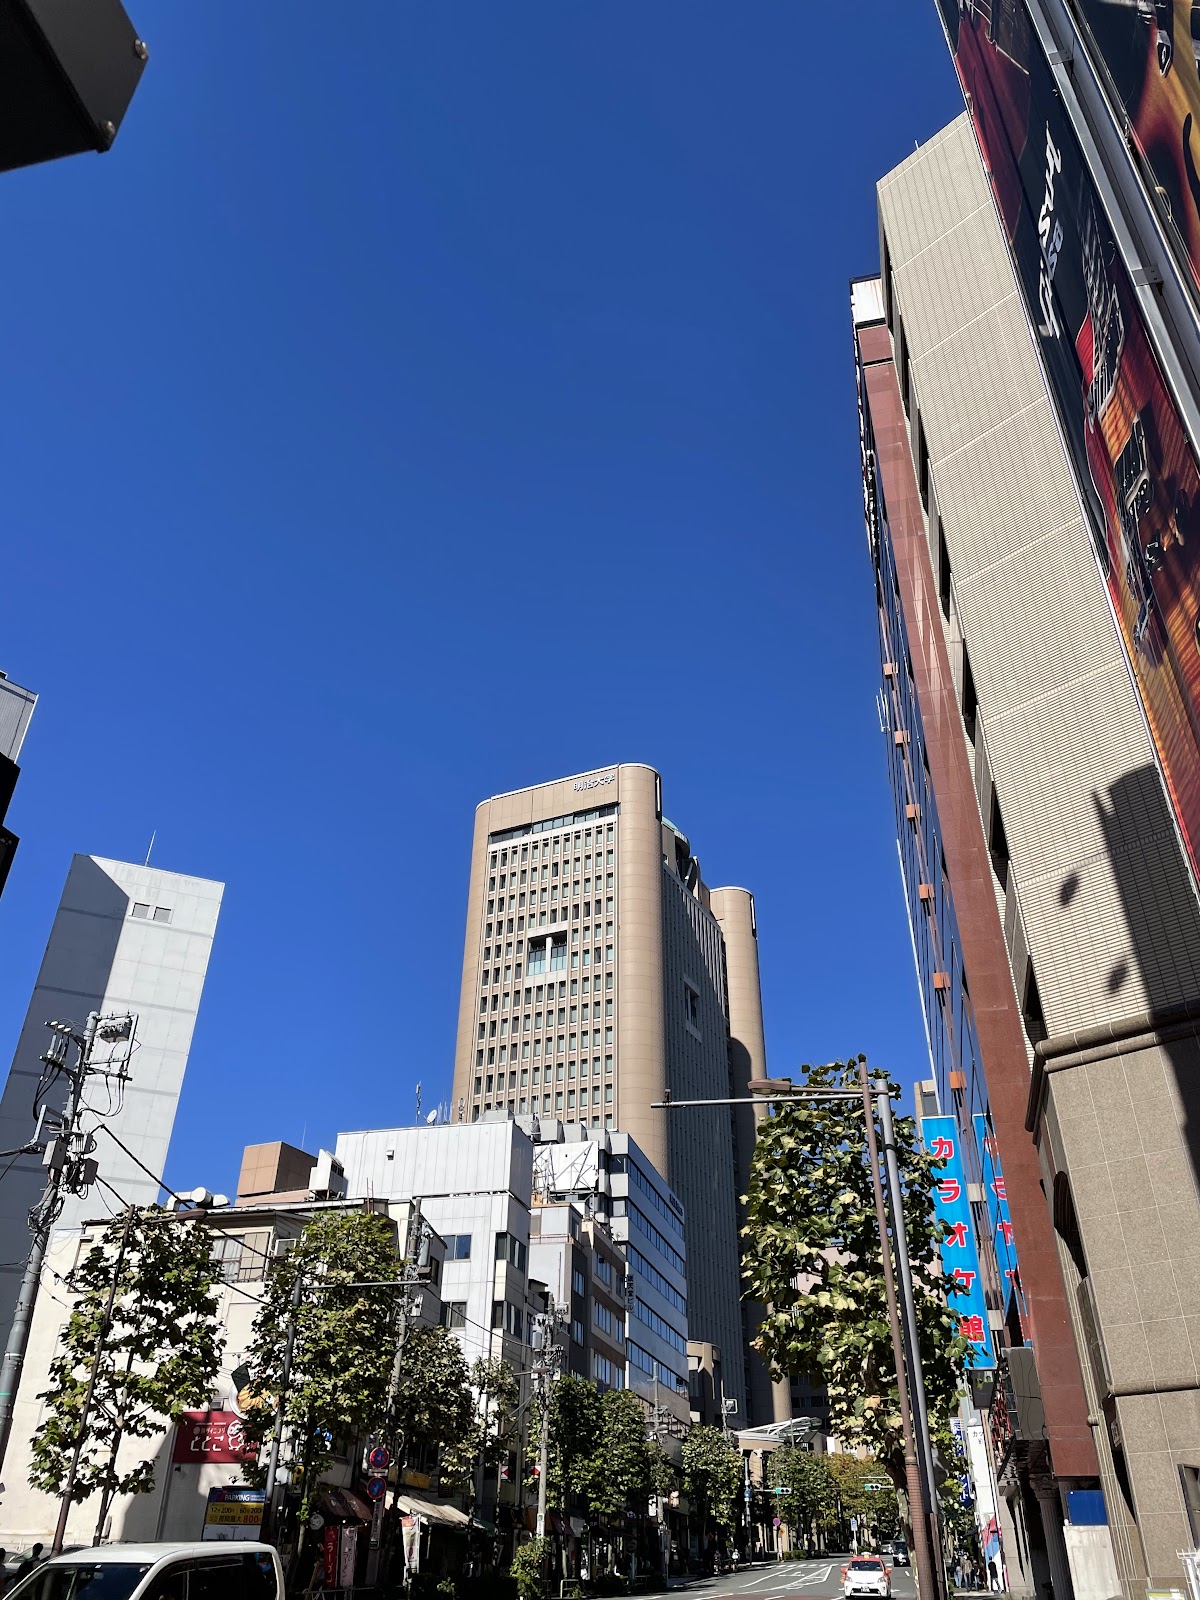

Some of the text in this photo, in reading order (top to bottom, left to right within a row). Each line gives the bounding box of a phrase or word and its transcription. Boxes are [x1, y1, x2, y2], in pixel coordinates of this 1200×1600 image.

[573, 772, 616, 792] 明治大学
[224, 1494, 250, 1502] PARKING
